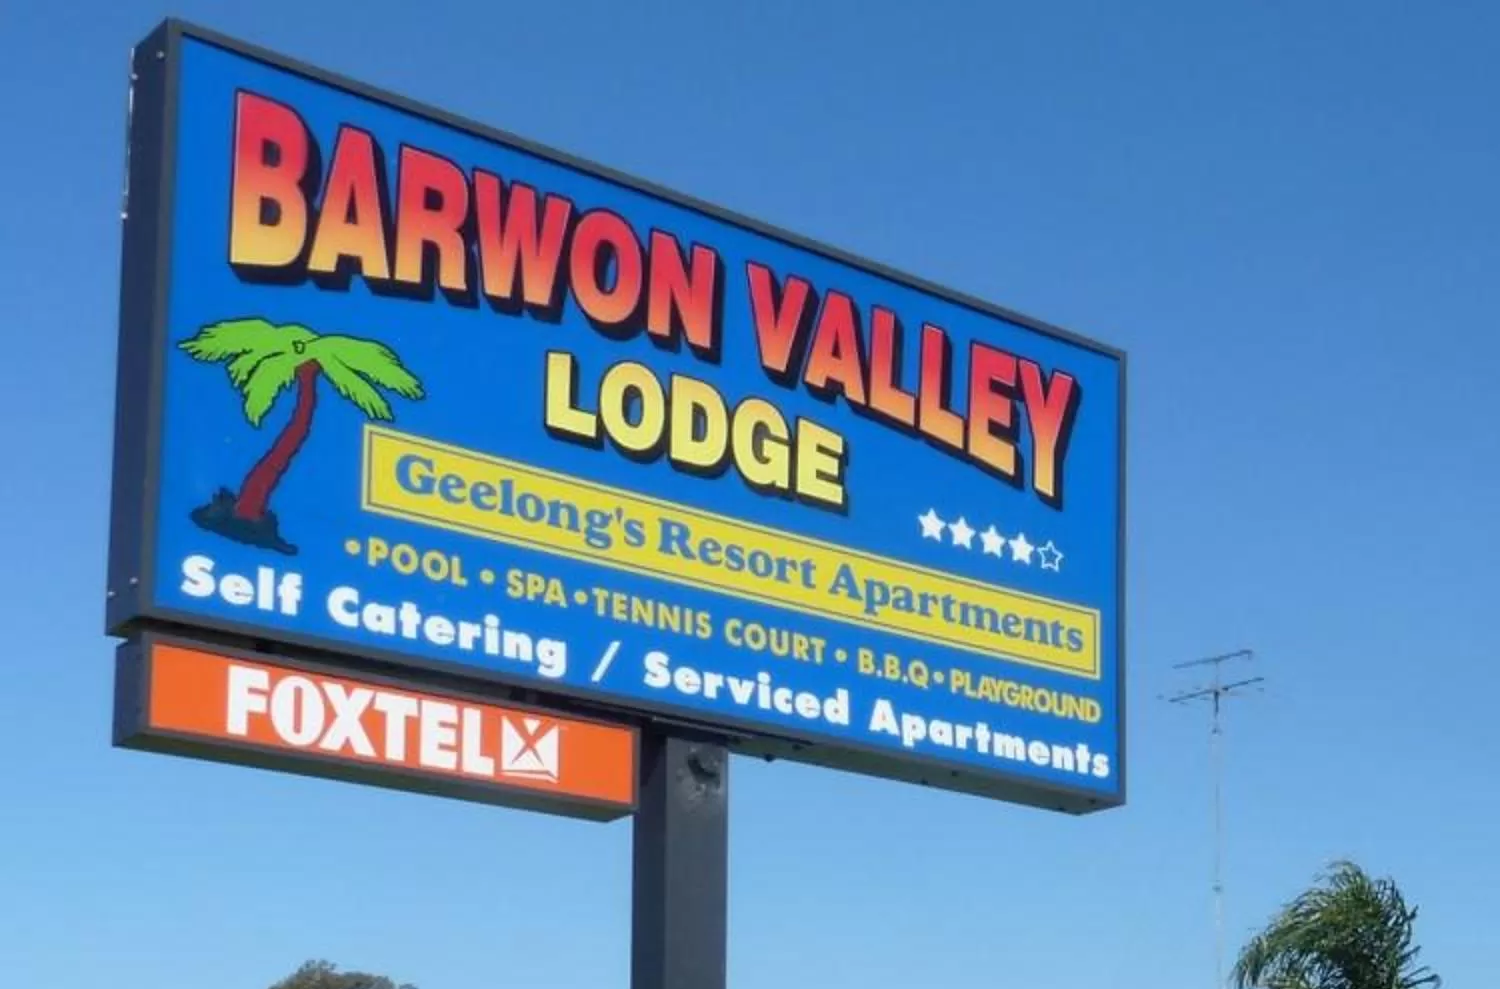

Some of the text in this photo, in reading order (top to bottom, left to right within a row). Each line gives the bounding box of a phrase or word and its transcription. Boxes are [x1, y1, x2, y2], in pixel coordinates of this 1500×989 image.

[229, 88, 1078, 502] BARWON VALLEY
[545, 351, 846, 511] LODGE
[366, 537, 468, 586] POOL
[506, 568, 567, 608] SPA
[592, 588, 712, 639] TENNIS
[724, 618, 826, 664] COURT
[950, 668, 1101, 723] PLAYGROUND
[395, 453, 1084, 653] Geelong's Resort Apartments
[180, 555, 302, 616] Self
[327, 586, 568, 678] Catering
[643, 650, 850, 726] Serviced
[868, 698, 1110, 778] Apartments
[226, 664, 496, 778] FOXTEL
